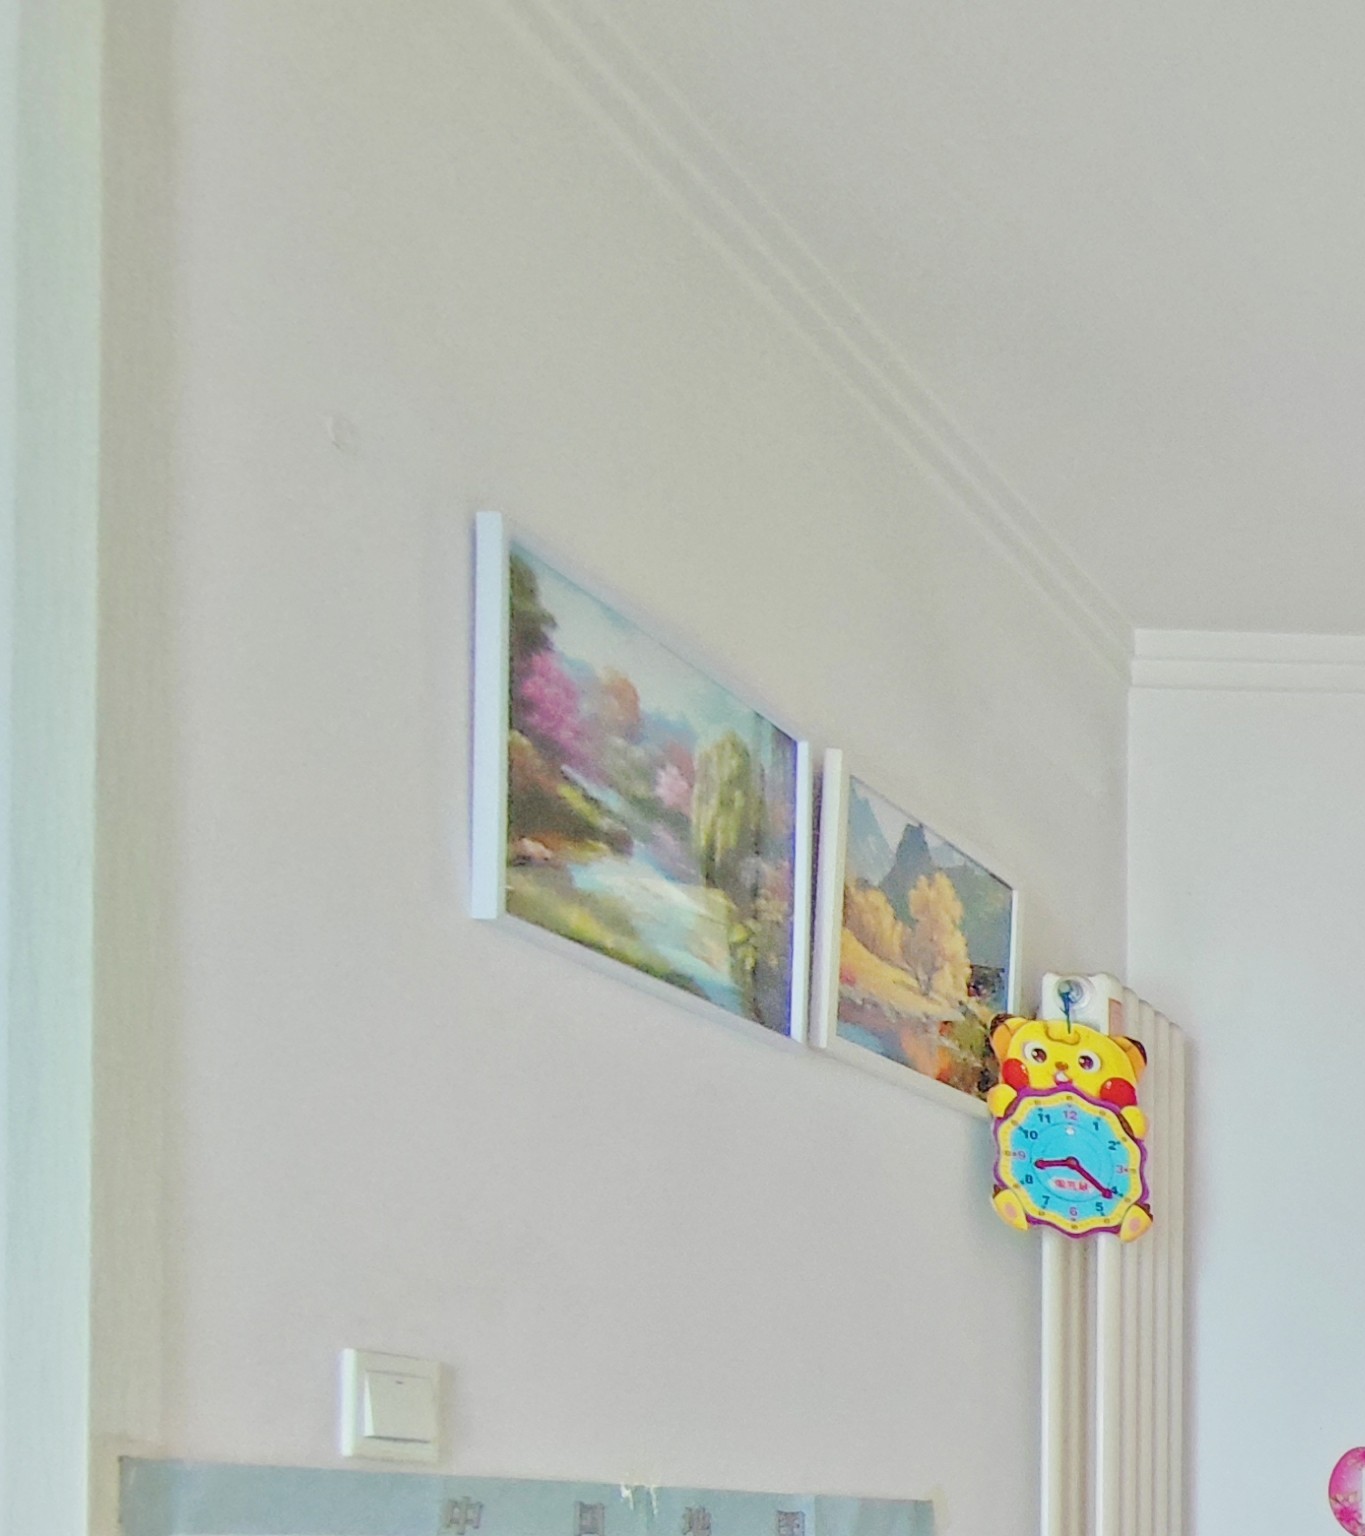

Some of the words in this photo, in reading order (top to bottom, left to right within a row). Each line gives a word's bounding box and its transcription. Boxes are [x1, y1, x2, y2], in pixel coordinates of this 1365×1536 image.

[1038, 1112, 1051, 1124] 11
[1063, 1110, 1077, 1121] 12
[1093, 1121, 1100, 1131] 1
[1024, 1129, 1038, 1140] 10
[1108, 1140, 1117, 1151] 2
[1017, 1150, 1026, 1160] 9
[1116, 1164, 1124, 1174] 3
[1025, 1174, 1034, 1185] 8
[1042, 1195, 1050, 1206] 7
[1069, 1207, 1078, 1217] 6
[1095, 1202, 1104, 1213] 5
